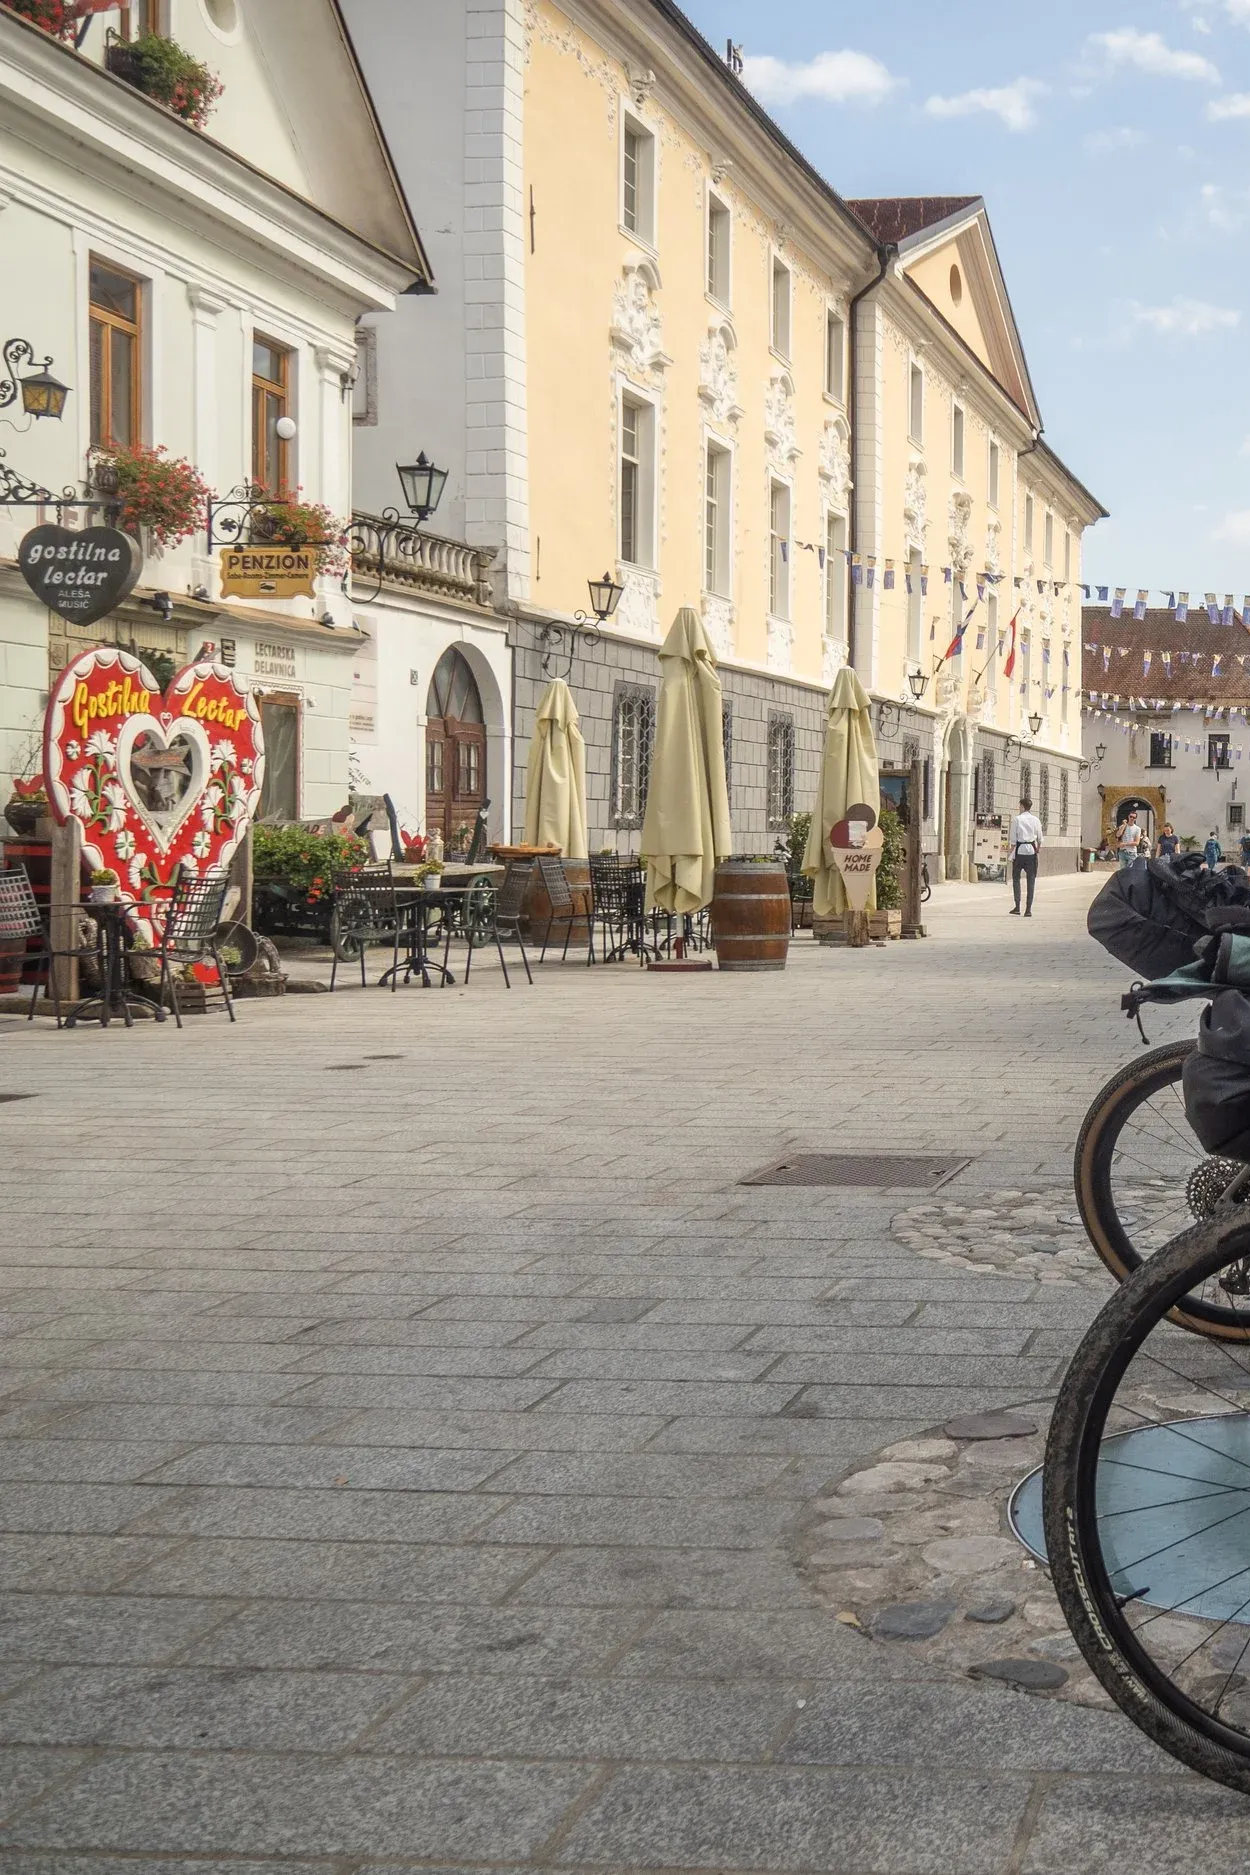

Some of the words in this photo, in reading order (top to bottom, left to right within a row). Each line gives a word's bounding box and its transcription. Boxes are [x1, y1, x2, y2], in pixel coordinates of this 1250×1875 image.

[28, 541, 121, 564] gostilna
[229, 555, 309, 570] PENZION
[44, 566, 108, 585] lectar
[58, 589, 91, 598] ALEŠA
[255, 642, 295, 661] LECTARSKA
[254, 660, 296, 678] DELAVNICA
[73, 676, 151, 739] Gostilna
[181, 683, 247, 731] Lectar
[844, 854, 872, 863] HOME
[844, 863, 871, 872] MADE
[1067, 1522, 1076, 1545] AT
[1069, 1545, 1113, 1650] CROSSCUT
